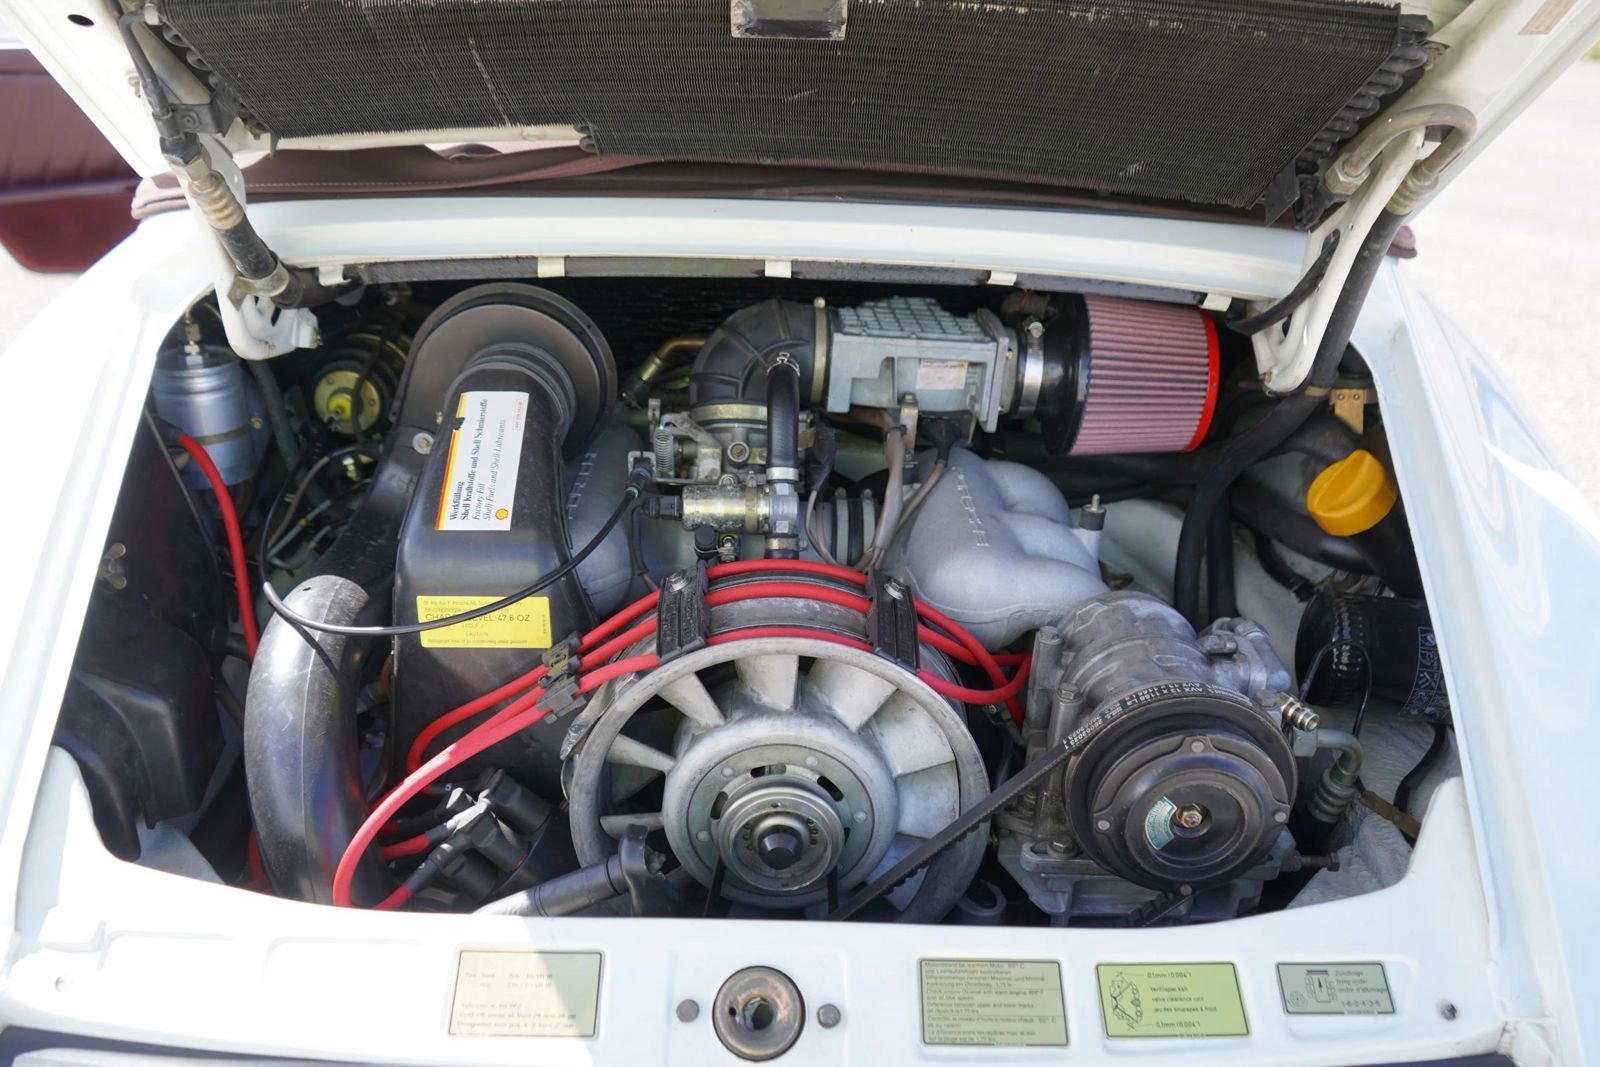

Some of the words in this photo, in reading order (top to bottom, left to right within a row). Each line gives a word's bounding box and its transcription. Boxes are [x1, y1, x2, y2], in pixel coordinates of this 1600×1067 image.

[476, 399, 488, 438] Schmierstoffe
[495, 419, 506, 451] Lubricants
[472, 440, 481, 456] Shell
[471, 456, 479, 469] und
[491, 452, 500, 469] Shell
[467, 470, 476, 501] Kraftstoffe
[478, 483, 486, 494] Fill
[488, 484, 496, 502] Fuels
[449, 481, 465, 520] Werkfüllung
[472, 494, 485, 520] Factory
[460, 501, 471, 521] Shell
[483, 503, 493, 521] Shell
